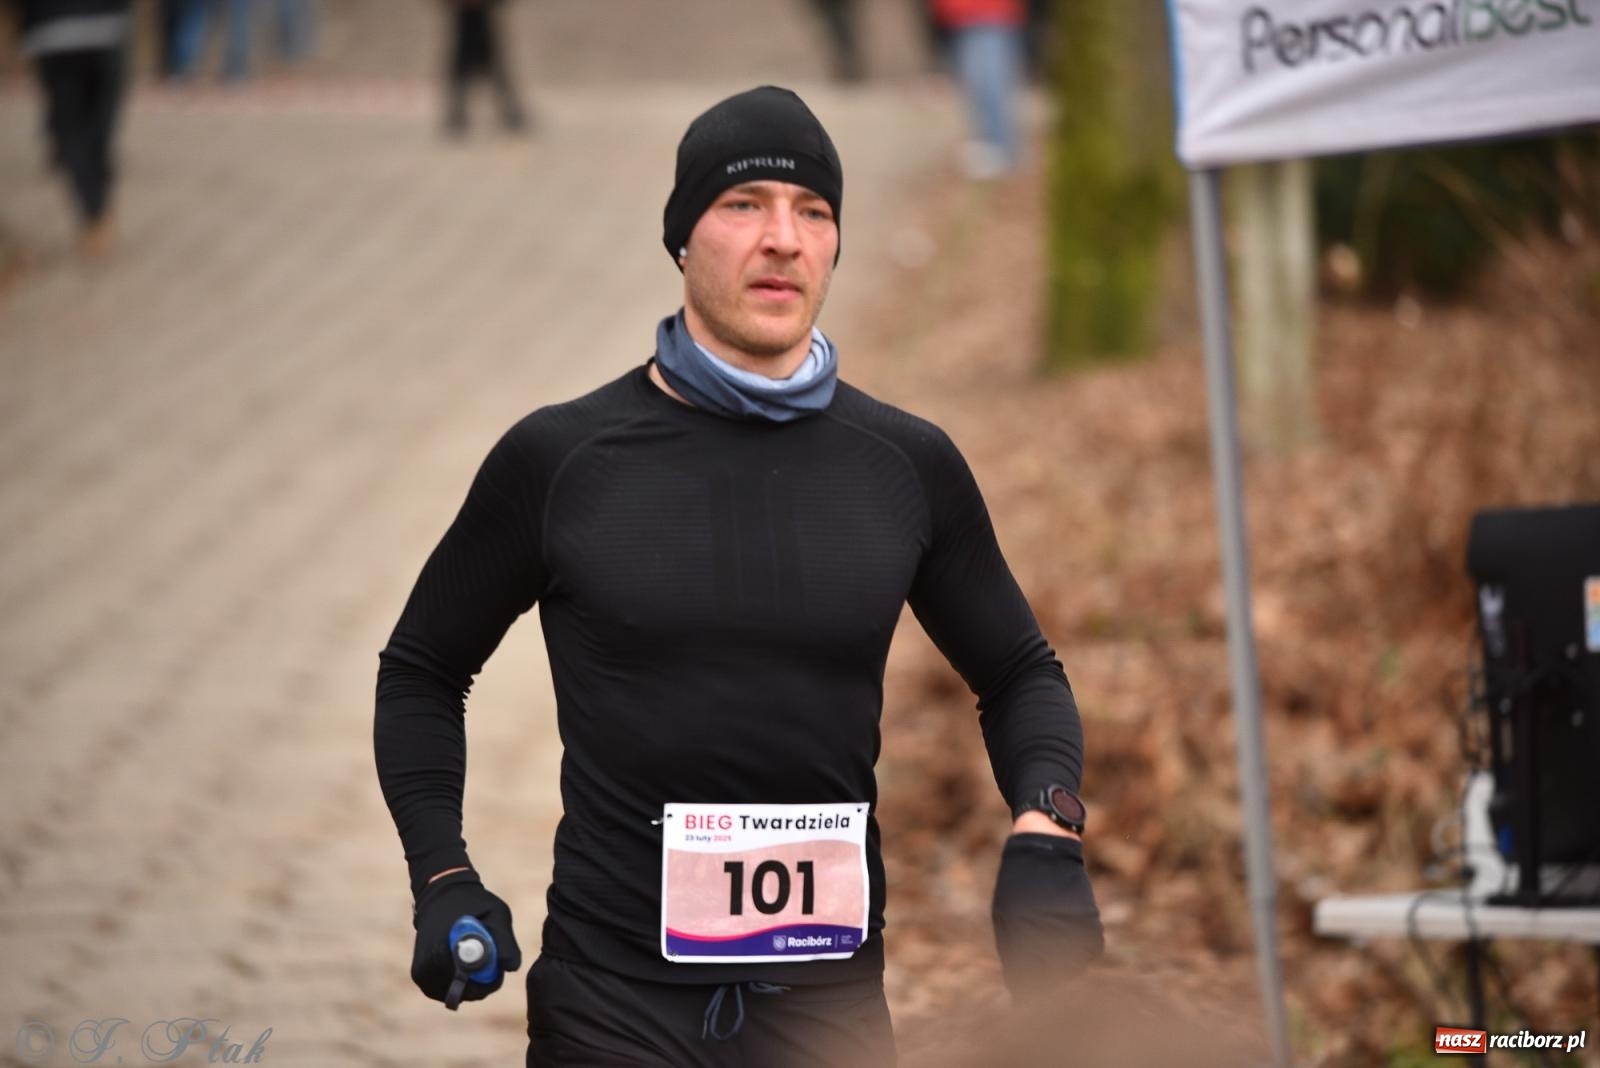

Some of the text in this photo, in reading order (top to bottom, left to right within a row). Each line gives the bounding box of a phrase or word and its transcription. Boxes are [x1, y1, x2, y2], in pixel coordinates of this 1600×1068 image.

[726, 156, 795, 174] KIPRUN
[685, 813, 850, 830] BIEG Twardziela
[696, 834, 711, 843] luty
[724, 860, 814, 915] 101
[788, 935, 832, 947] Racibórz
